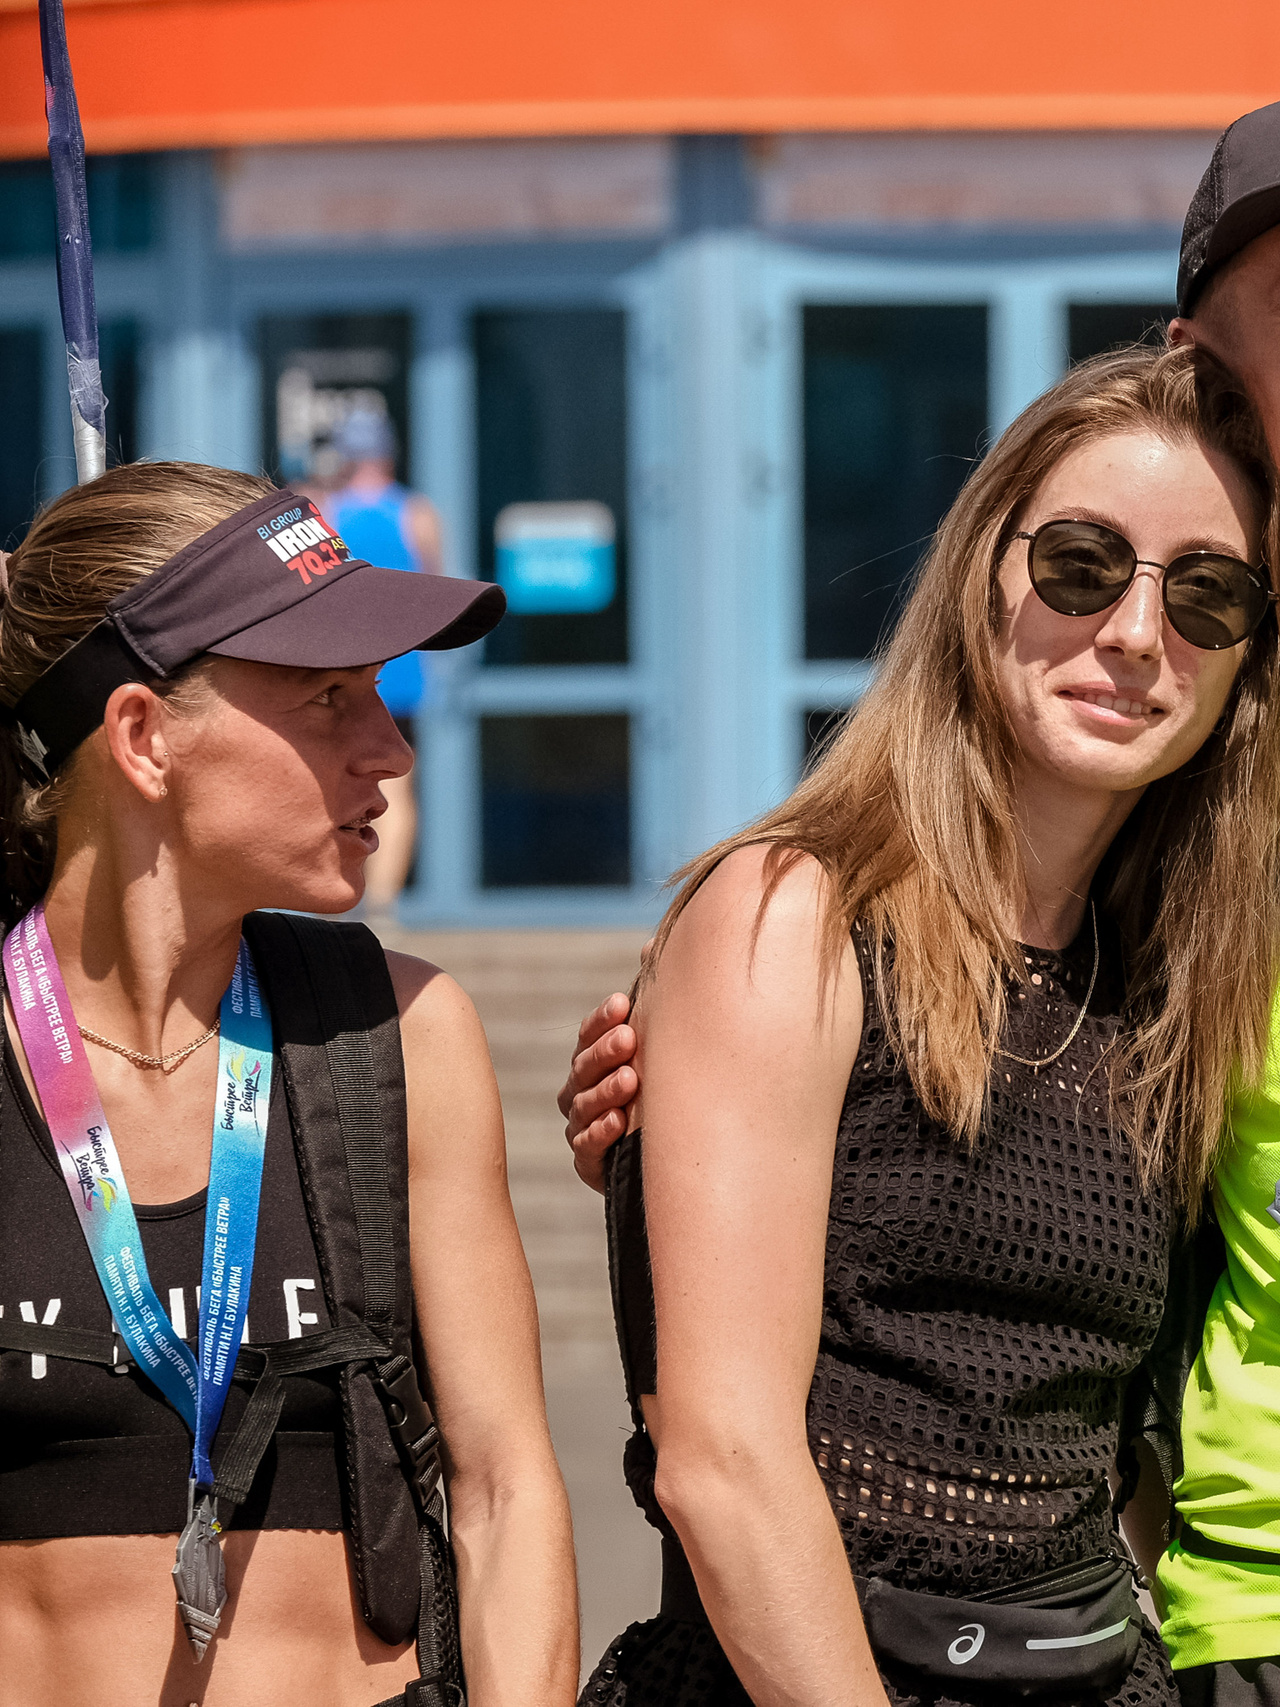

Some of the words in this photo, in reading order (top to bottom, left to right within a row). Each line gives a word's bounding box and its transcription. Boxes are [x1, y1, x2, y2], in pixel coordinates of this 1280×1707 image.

[256, 524, 272, 540] BI
[269, 507, 303, 531] GROUP
[286, 542, 342, 585] 70.3
[29, 948, 47, 978] БЕГА
[37, 973, 63, 1028] «БЫСТРЕЕ
[249, 984, 262, 1018] ПАМЯТИ
[52, 1025, 74, 1064] ВЕТРА»
[216, 1196, 231, 1234] ВЕТРА»
[103, 1254, 127, 1298] ПАМЯТИ
[212, 1236, 227, 1289] «БЫСТРЕЕ
[120, 1246, 144, 1306] ФЕСТИВАЛЬ
[139, 1304, 159, 1334] БЕГА
[153, 1329, 188, 1377] «БЫСТРЕЕ
[208, 1289, 222, 1317] БЕГА
[203, 1317, 218, 1381] ФЕСТИВАЛЬ
[212, 1342, 231, 1386] ПАМЯТИ
